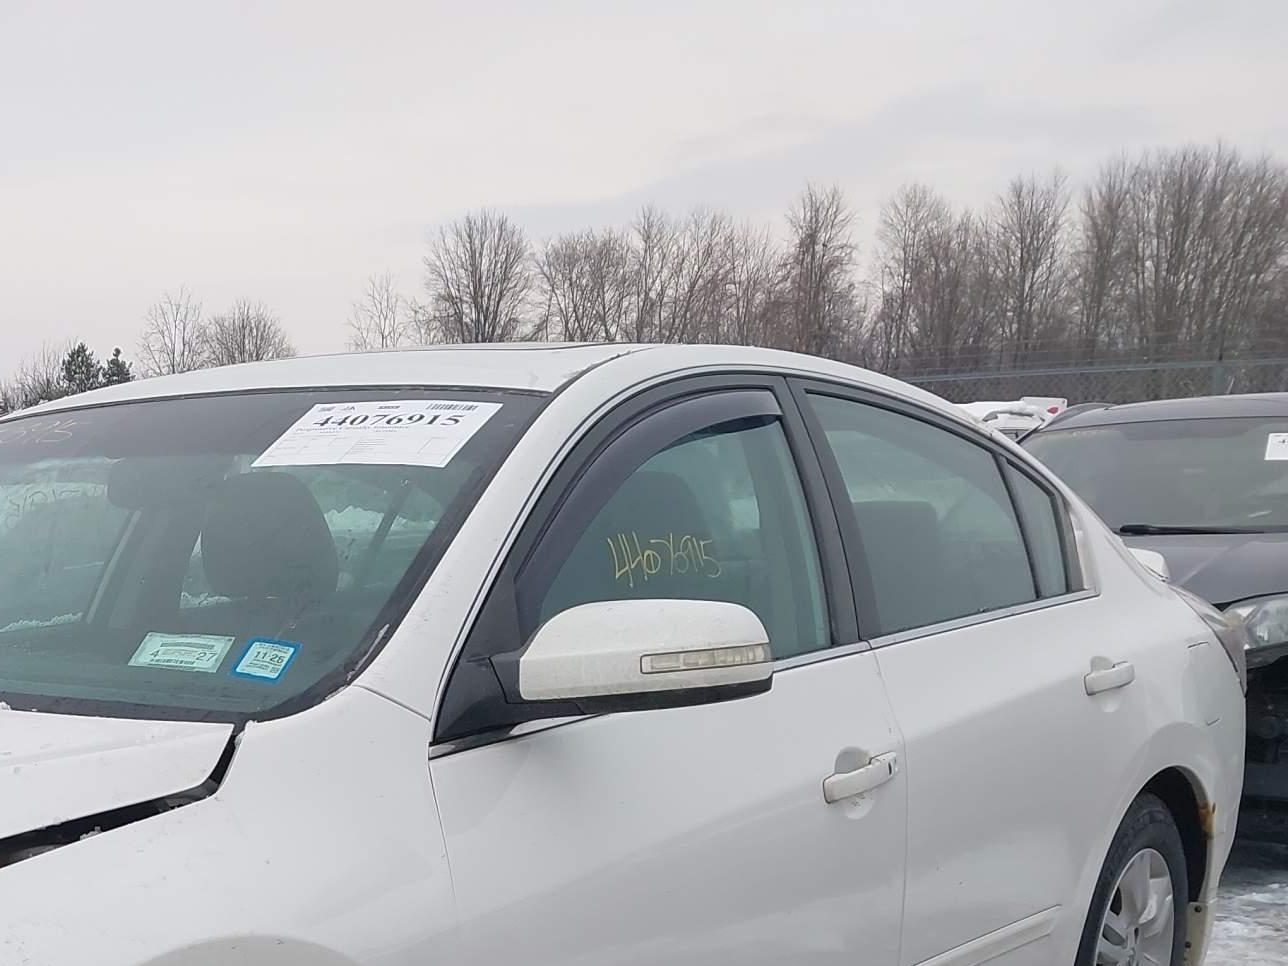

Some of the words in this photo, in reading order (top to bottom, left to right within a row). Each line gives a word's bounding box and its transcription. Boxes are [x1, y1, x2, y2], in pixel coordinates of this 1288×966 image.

[313, 413, 464, 427] 44076915
[607, 531, 722, 589] 44076915
[195, 651, 217, 663] 27
